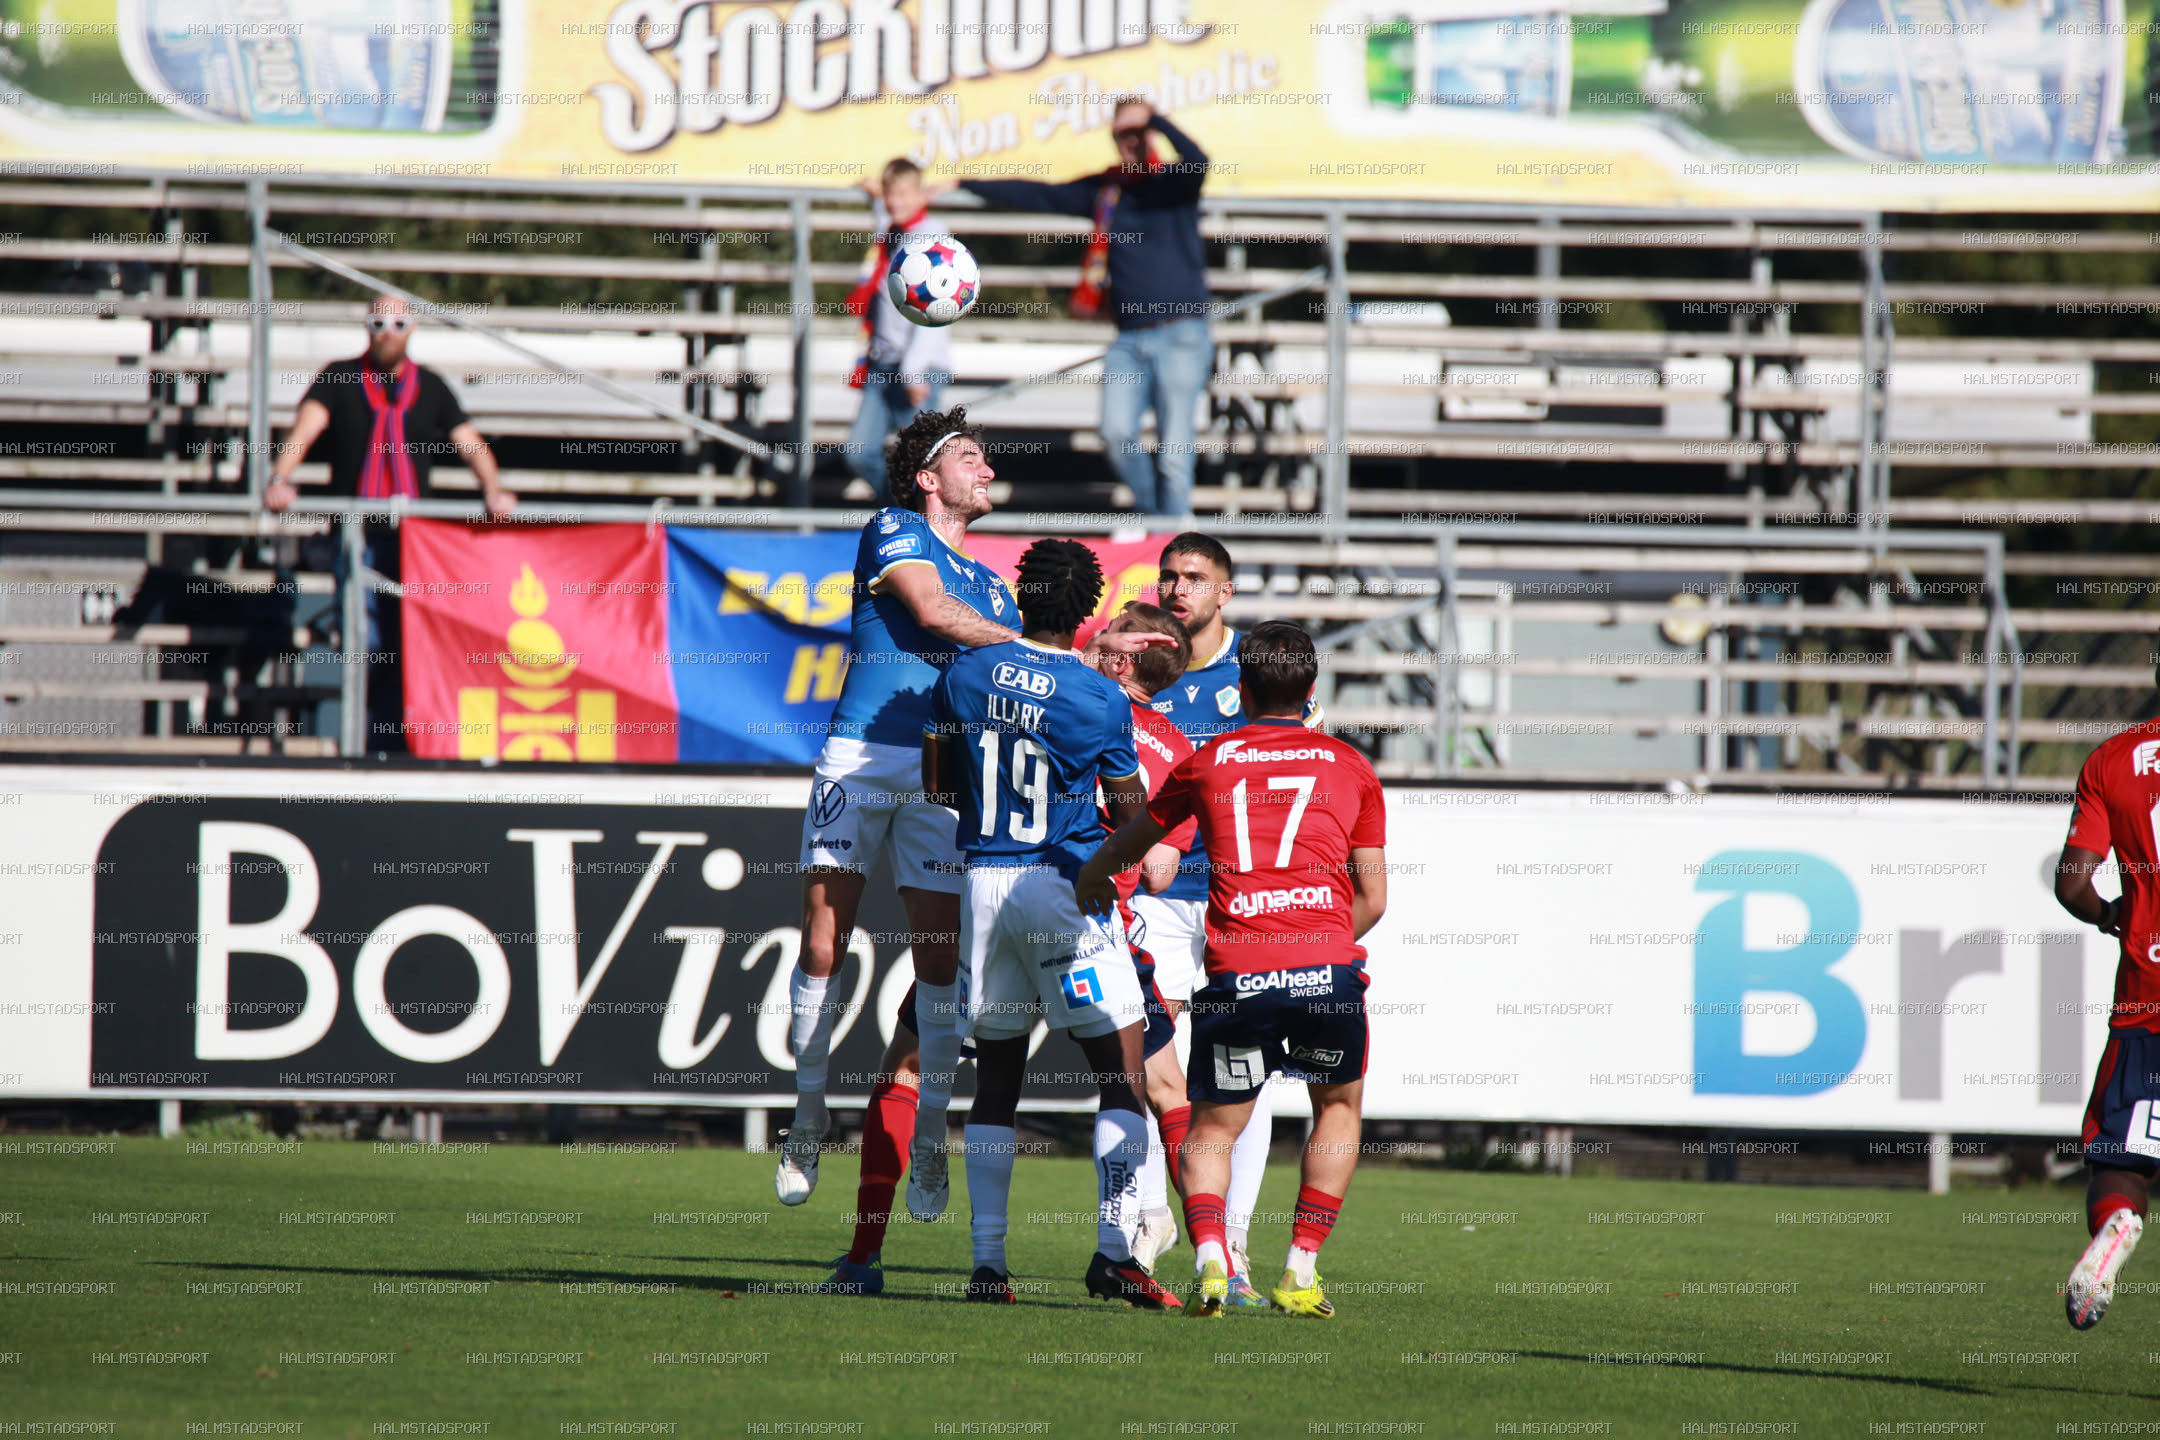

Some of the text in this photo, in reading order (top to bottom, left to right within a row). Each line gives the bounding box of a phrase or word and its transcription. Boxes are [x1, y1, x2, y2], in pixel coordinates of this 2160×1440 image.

[907, 103, 1020, 168] Non
[879, 538, 916, 556] UNIBET
[784, 643, 850, 704] H
[997, 665, 1050, 696] EAB
[987, 694, 1046, 732] ILLARY
[1222, 747, 1336, 765] Fellessons
[978, 730, 1049, 844] 19
[1232, 776, 1317, 872] 17
[1229, 886, 1333, 918] dynacon
[1235, 964, 1332, 992] GoAhead
[1290, 984, 1333, 998] SWEDEN
[1125, 1172, 1137, 1198] GN
